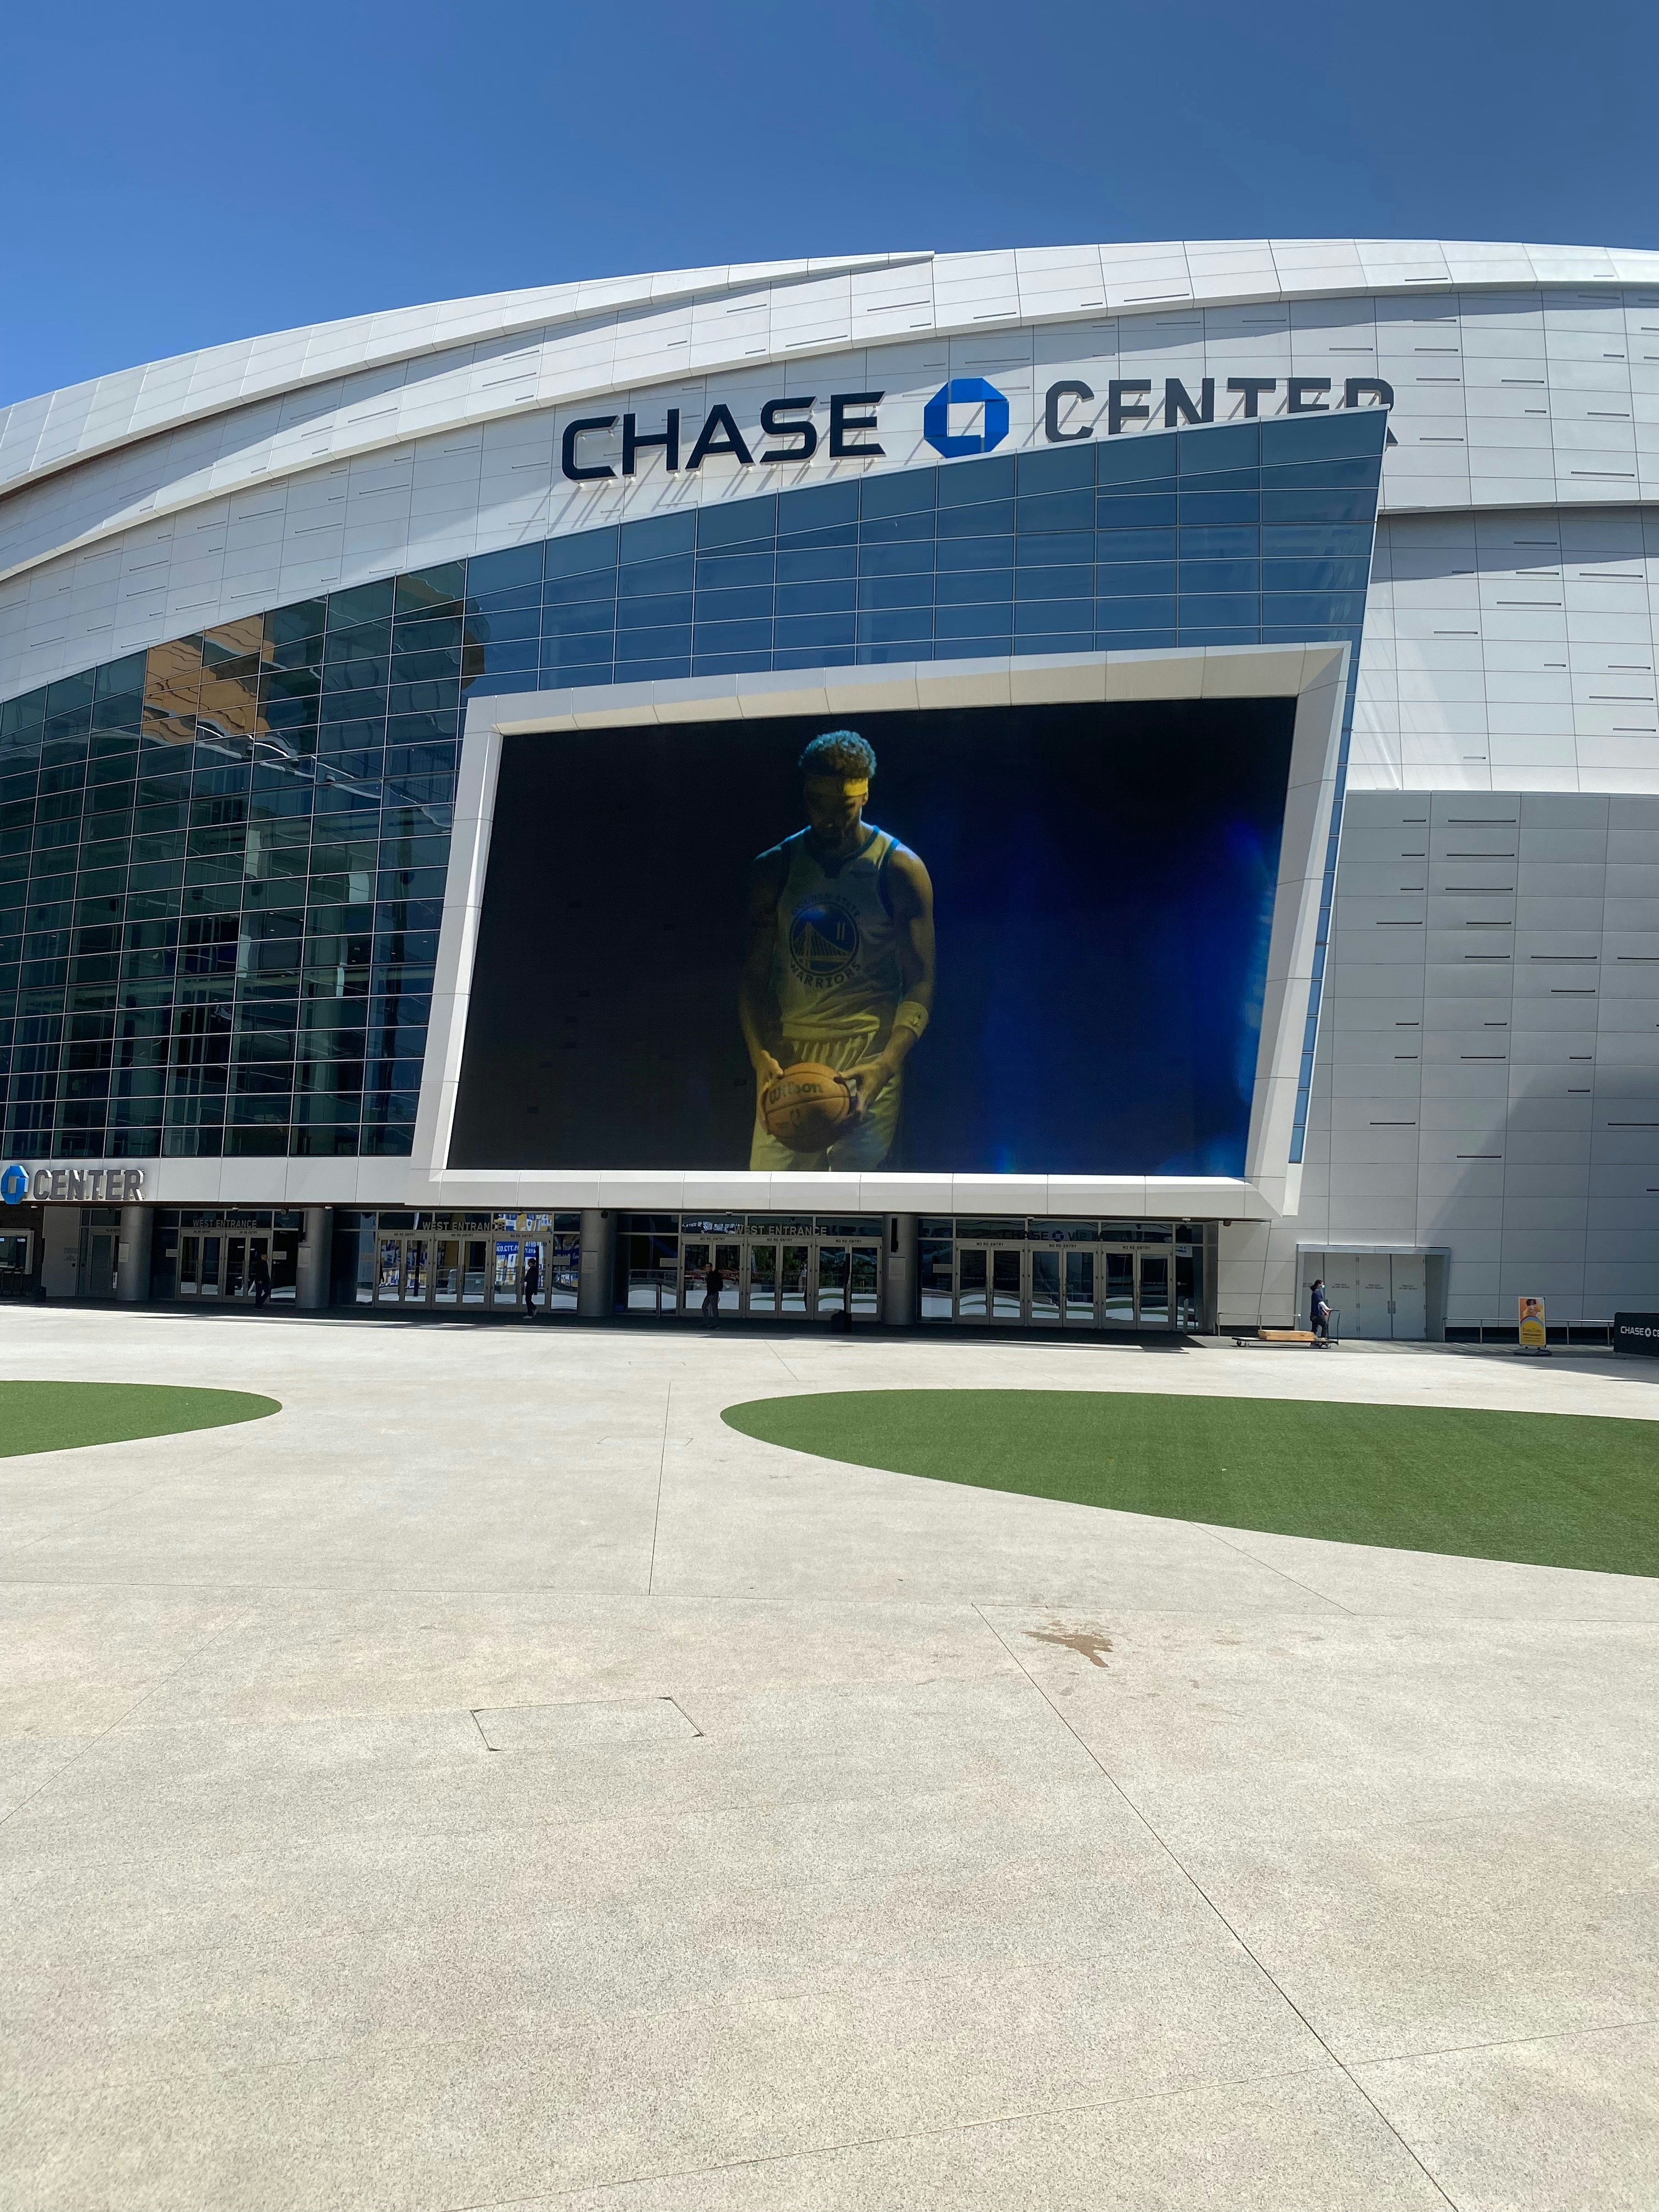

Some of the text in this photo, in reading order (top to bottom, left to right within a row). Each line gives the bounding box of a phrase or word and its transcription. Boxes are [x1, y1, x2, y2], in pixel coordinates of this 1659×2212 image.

[561, 391, 885, 483] CHASE
[837, 921, 845, 941] 11
[791, 959, 861, 988] WARRIORS
[769, 1081, 823, 1104] Wilson
[33, 1169, 144, 1201] CENTER
[216, 1220, 257, 1228] ENTRANCE
[422, 1221, 505, 1232] WEST ENTRANCE
[735, 1225, 827, 1236] WEST ENTRANCE
[1002, 1230, 1049, 1241] CHASE
[1620, 1325, 1645, 1336] CHASE
